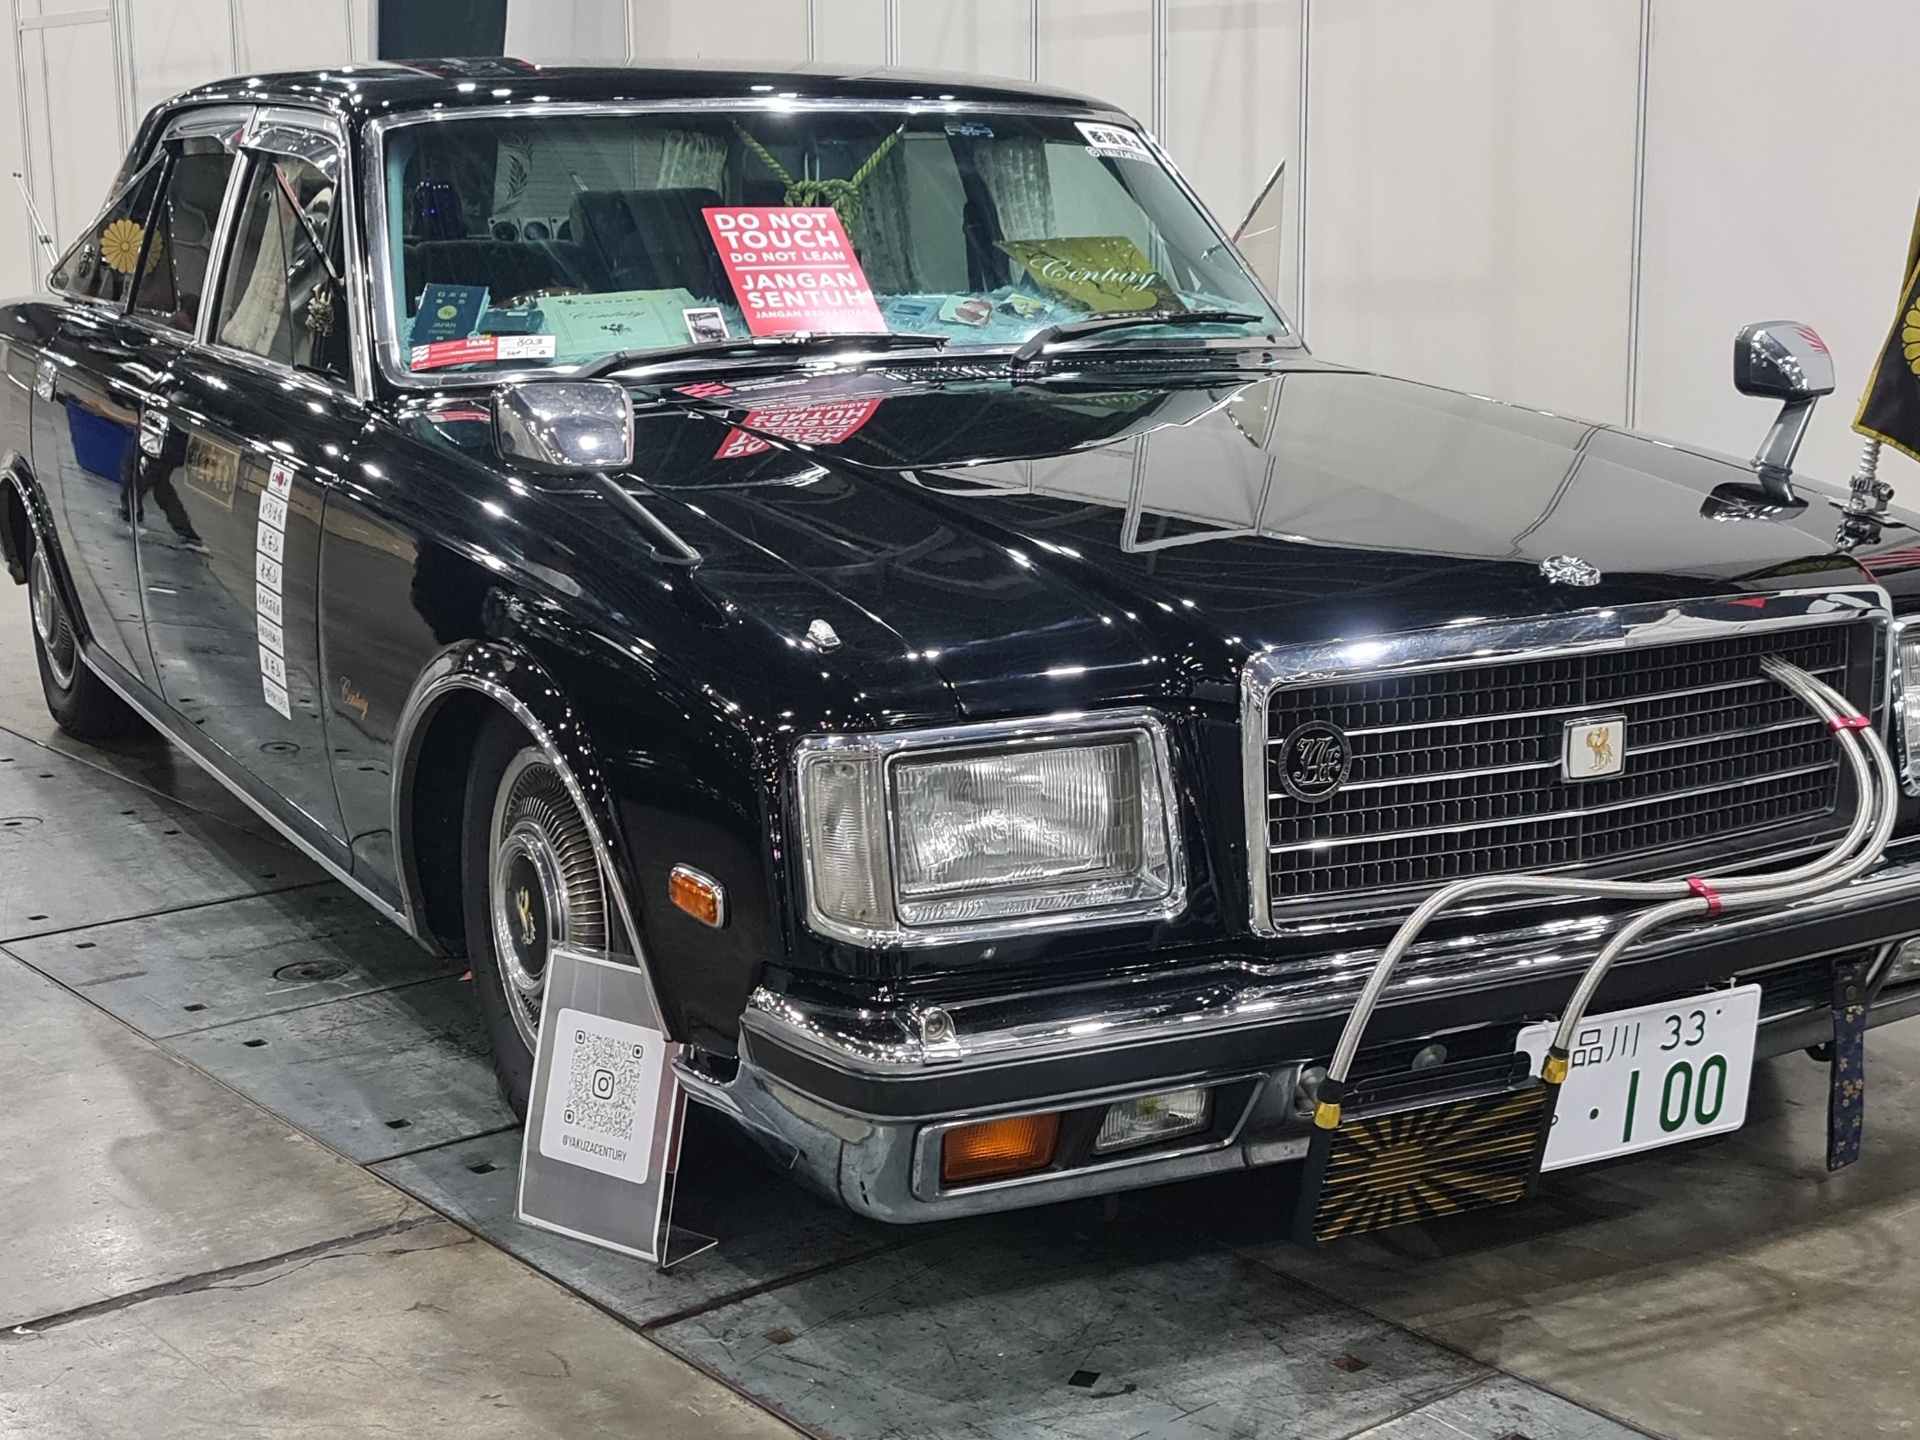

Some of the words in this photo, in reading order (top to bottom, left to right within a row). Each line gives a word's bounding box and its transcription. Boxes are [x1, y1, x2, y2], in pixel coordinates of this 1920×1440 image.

[714, 213, 759, 230] DO
[768, 213, 827, 229] NOT
[720, 230, 840, 249] TOUCH
[730, 252, 757, 263] DO
[762, 252, 797, 262] NOT
[802, 251, 845, 261] LEAN
[742, 272, 858, 290] JANGAN
[1030, 259, 1157, 291] Century
[747, 289, 870, 308] SENTUH
[755, 310, 800, 319] JANGAN
[1571, 1022, 1640, 1068] 品川
[1660, 1010, 1706, 1051] 33
[562, 1134, 628, 1162] @YAKUZACENTURY
